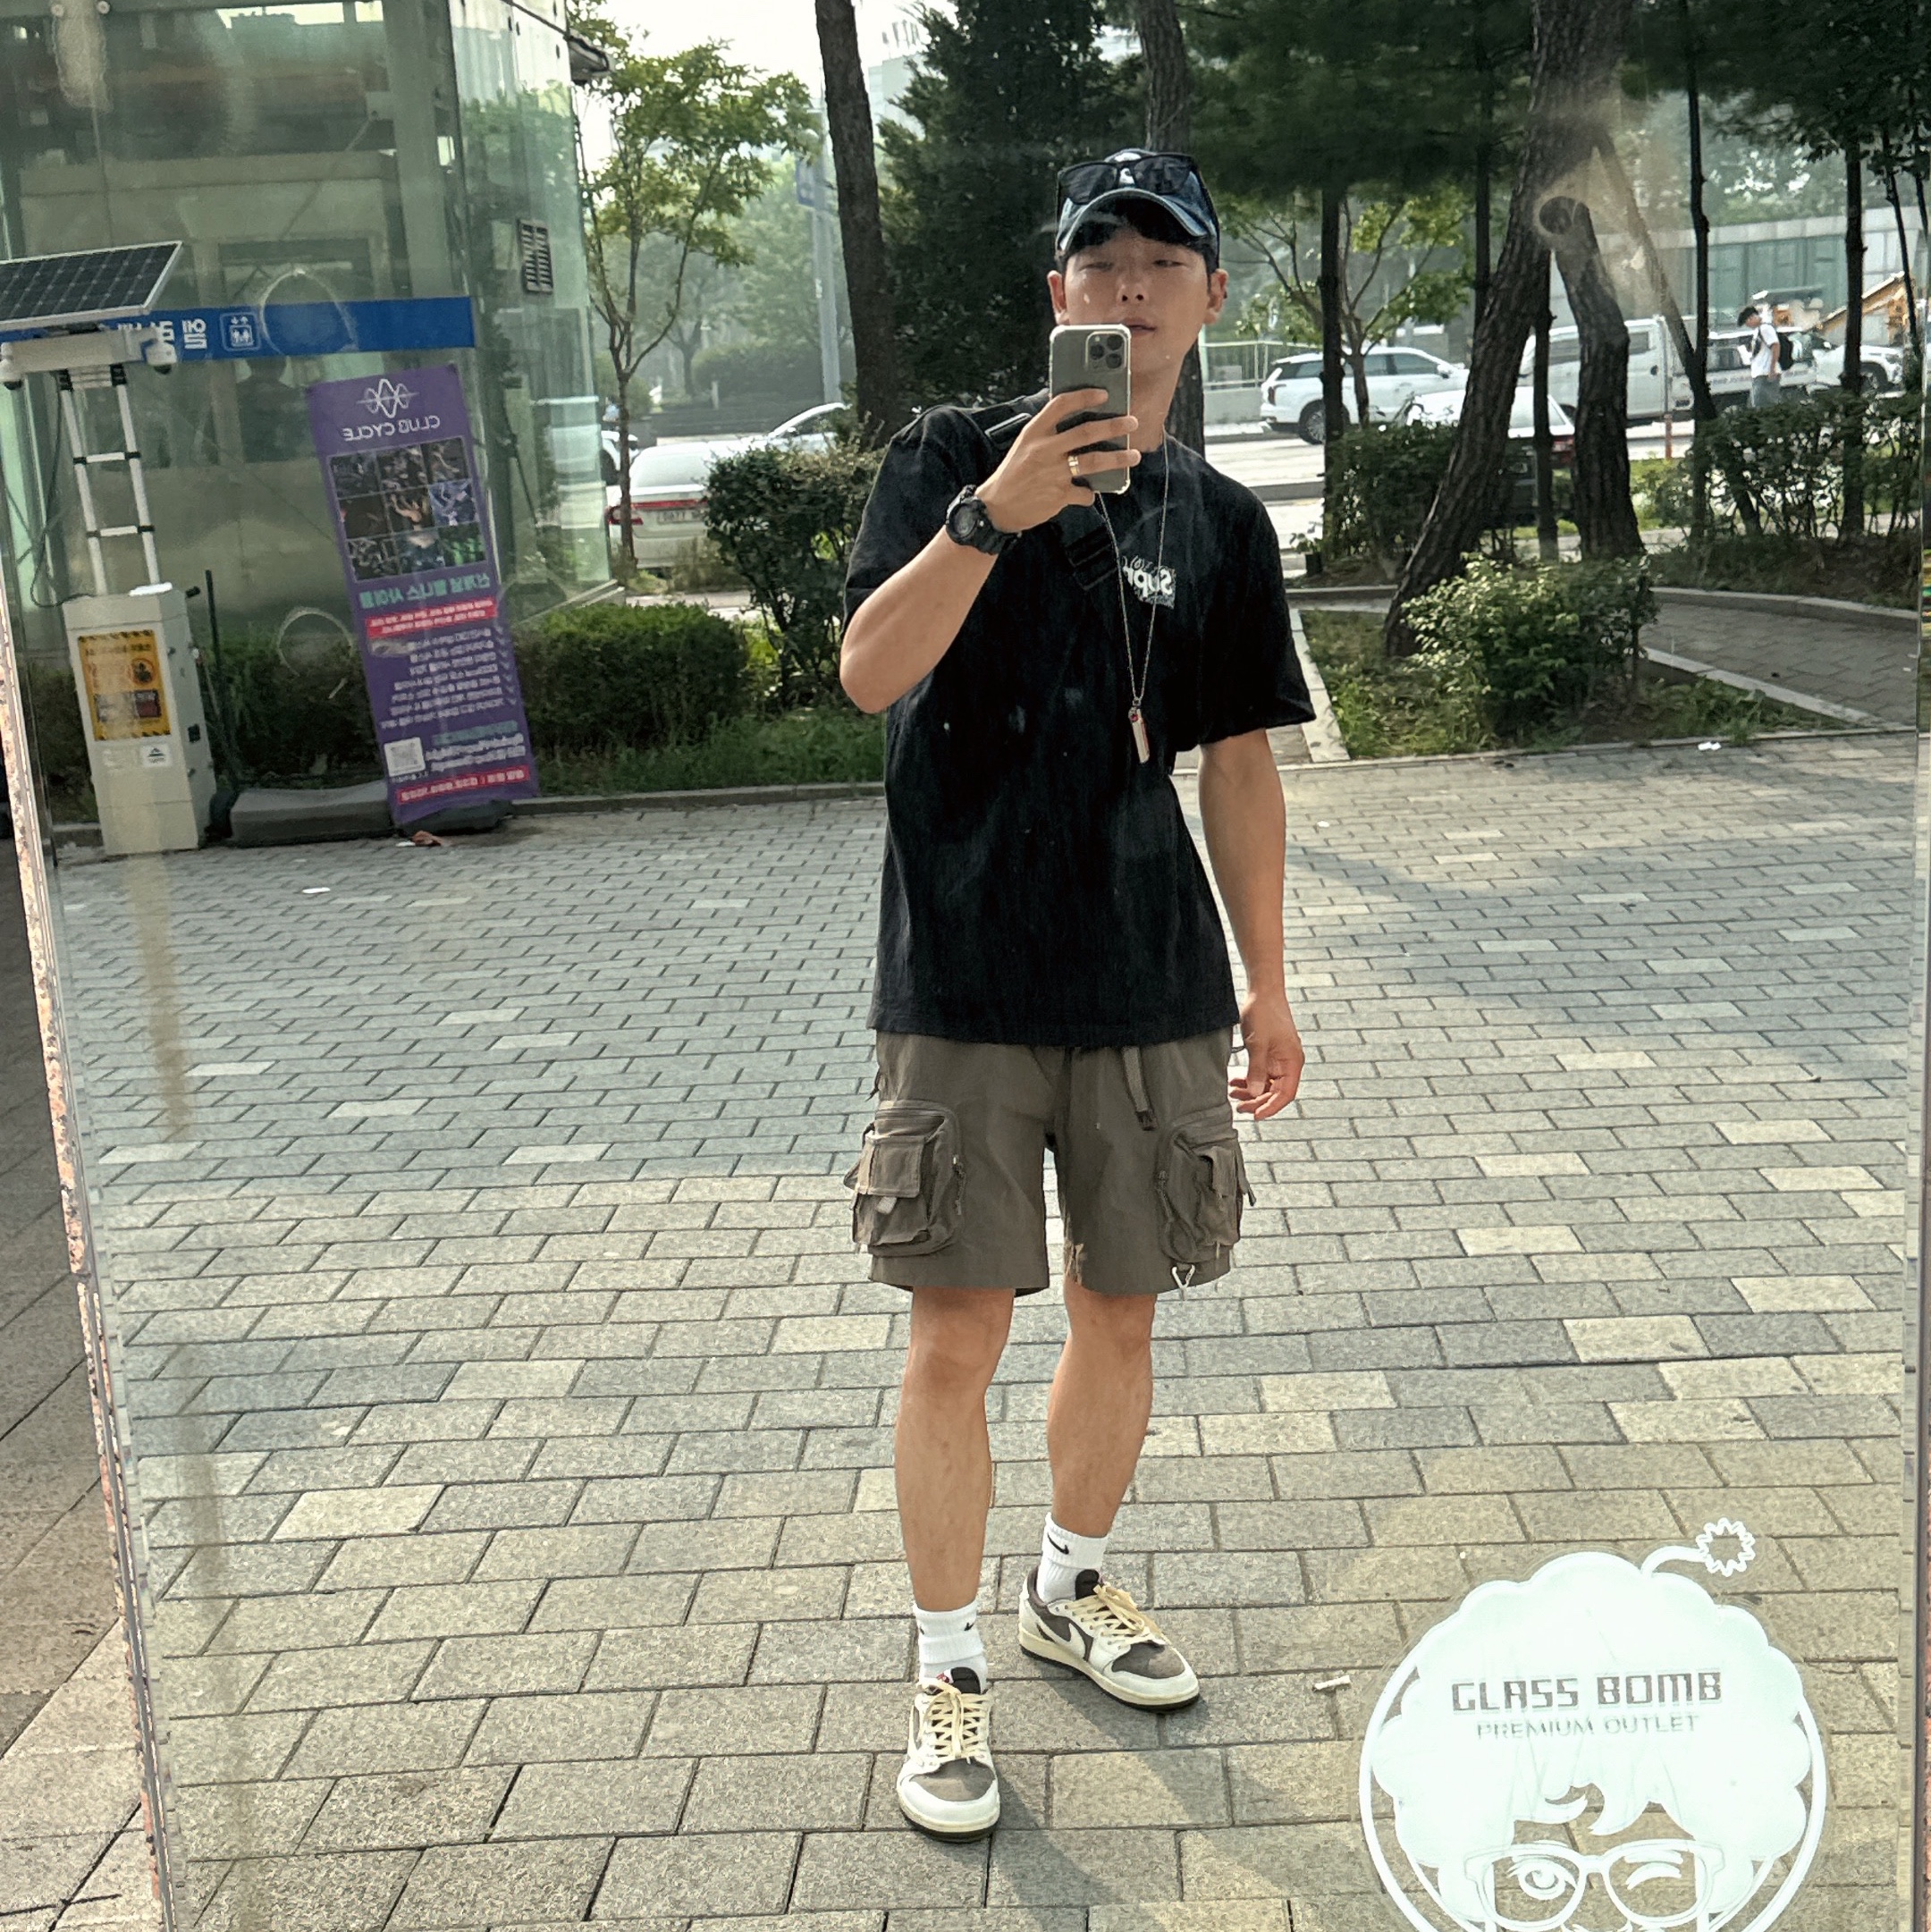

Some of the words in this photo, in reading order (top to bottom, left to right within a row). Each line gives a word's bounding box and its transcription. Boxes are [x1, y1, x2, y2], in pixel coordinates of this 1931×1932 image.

[1451, 1676, 1580, 1713] GLASS
[1477, 1717, 1595, 1740] PREMIUM
[1604, 1714, 1700, 1734] OUTLET
